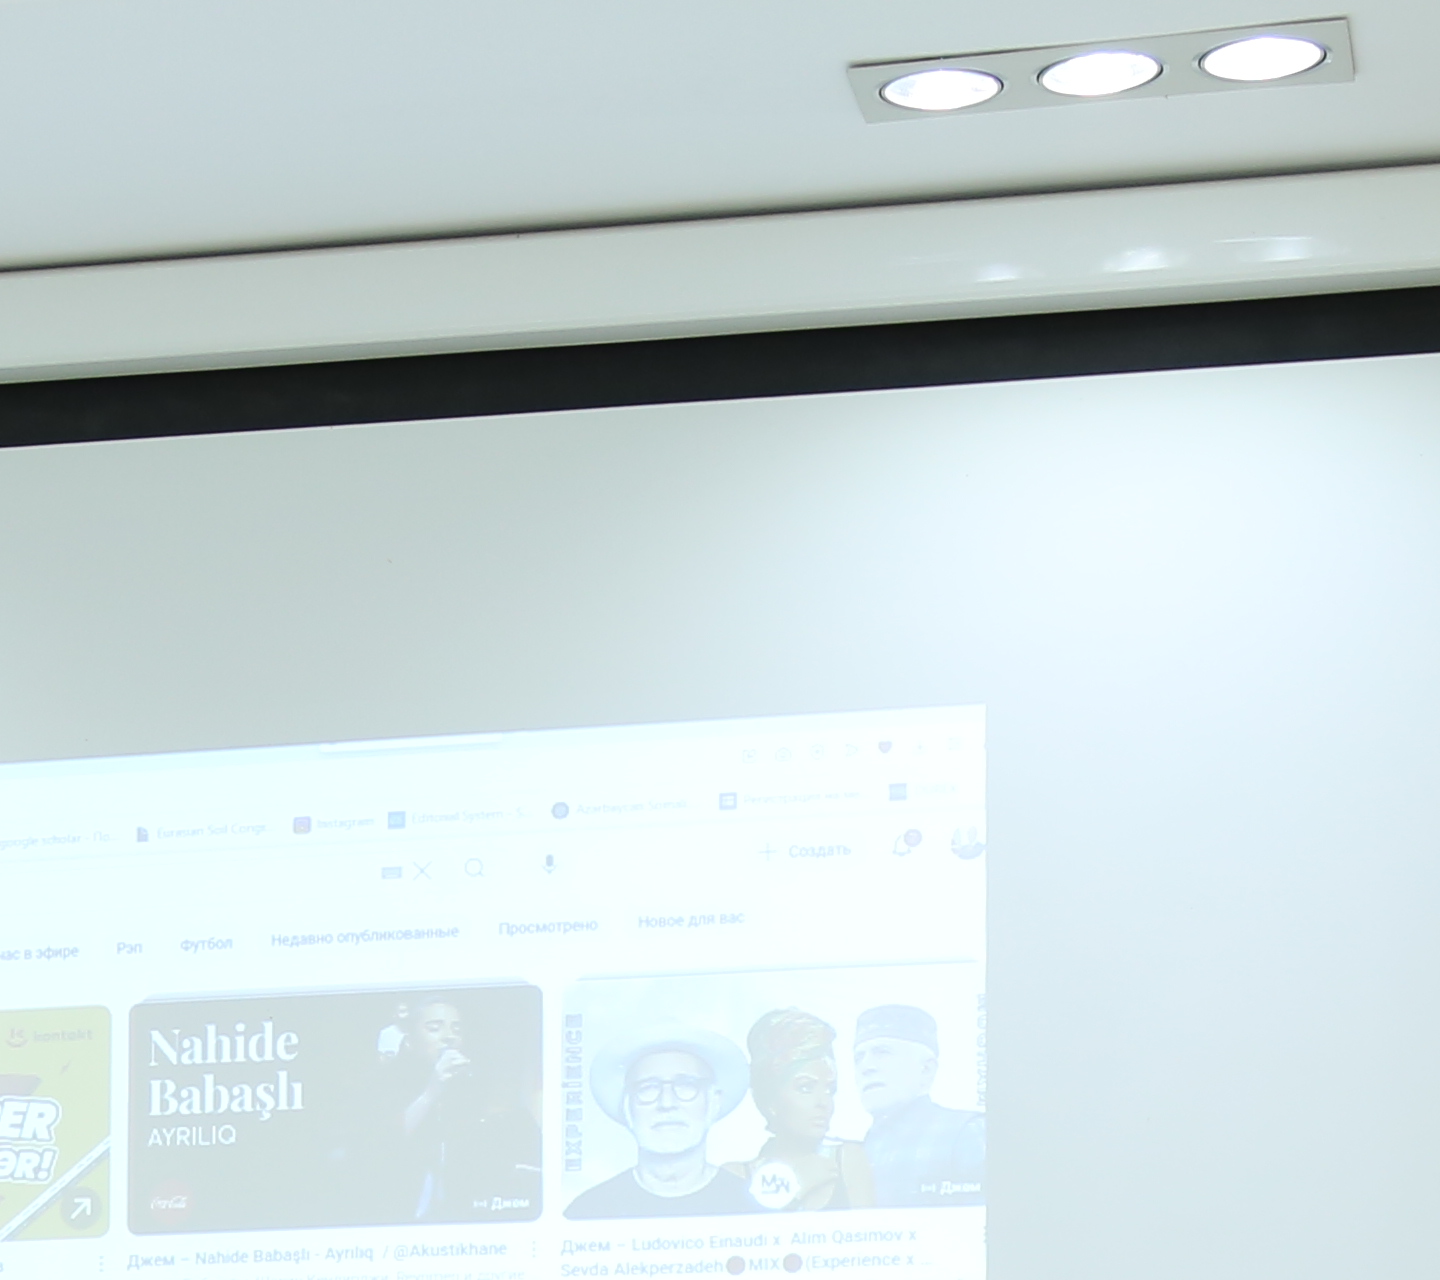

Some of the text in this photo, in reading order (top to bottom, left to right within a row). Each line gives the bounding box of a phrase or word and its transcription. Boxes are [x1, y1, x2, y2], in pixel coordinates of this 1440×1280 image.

[789, 844, 852, 859] Создать
[498, 918, 598, 938] Просмотрено
[638, 912, 745, 929] Новое для вас
[180, 935, 233, 954] Футбол
[271, 924, 460, 948] Недавно опубликованные
[24, 949, 32, 960] в
[36, 945, 80, 962] эфире
[116, 941, 143, 956] Рэп
[149, 1021, 299, 1067] Nahide
[148, 1070, 305, 1121] Babaşlı
[147, 1124, 237, 1147] AYRILIQ
[560, 1240, 611, 1257] Джем
[632, 1236, 704, 1252] Ludovico
[709, 1233, 768, 1250] Einaudi
[772, 1236, 781, 1247] x
[790, 1230, 827, 1246] Alim
[908, 1230, 917, 1241] x
[127, 1254, 176, 1271] Джем
[195, 1250, 249, 1267] Nahide
[253, 1247, 310, 1265] Babaşlı
[393, 1241, 508, 1262] @Akustikhane
[560, 1261, 609, 1278] Sevda
[613, 1257, 725, 1278] Alekperzadeh
[748, 1257, 781, 1272] MIX
[805, 1252, 901, 1273] (Experience
